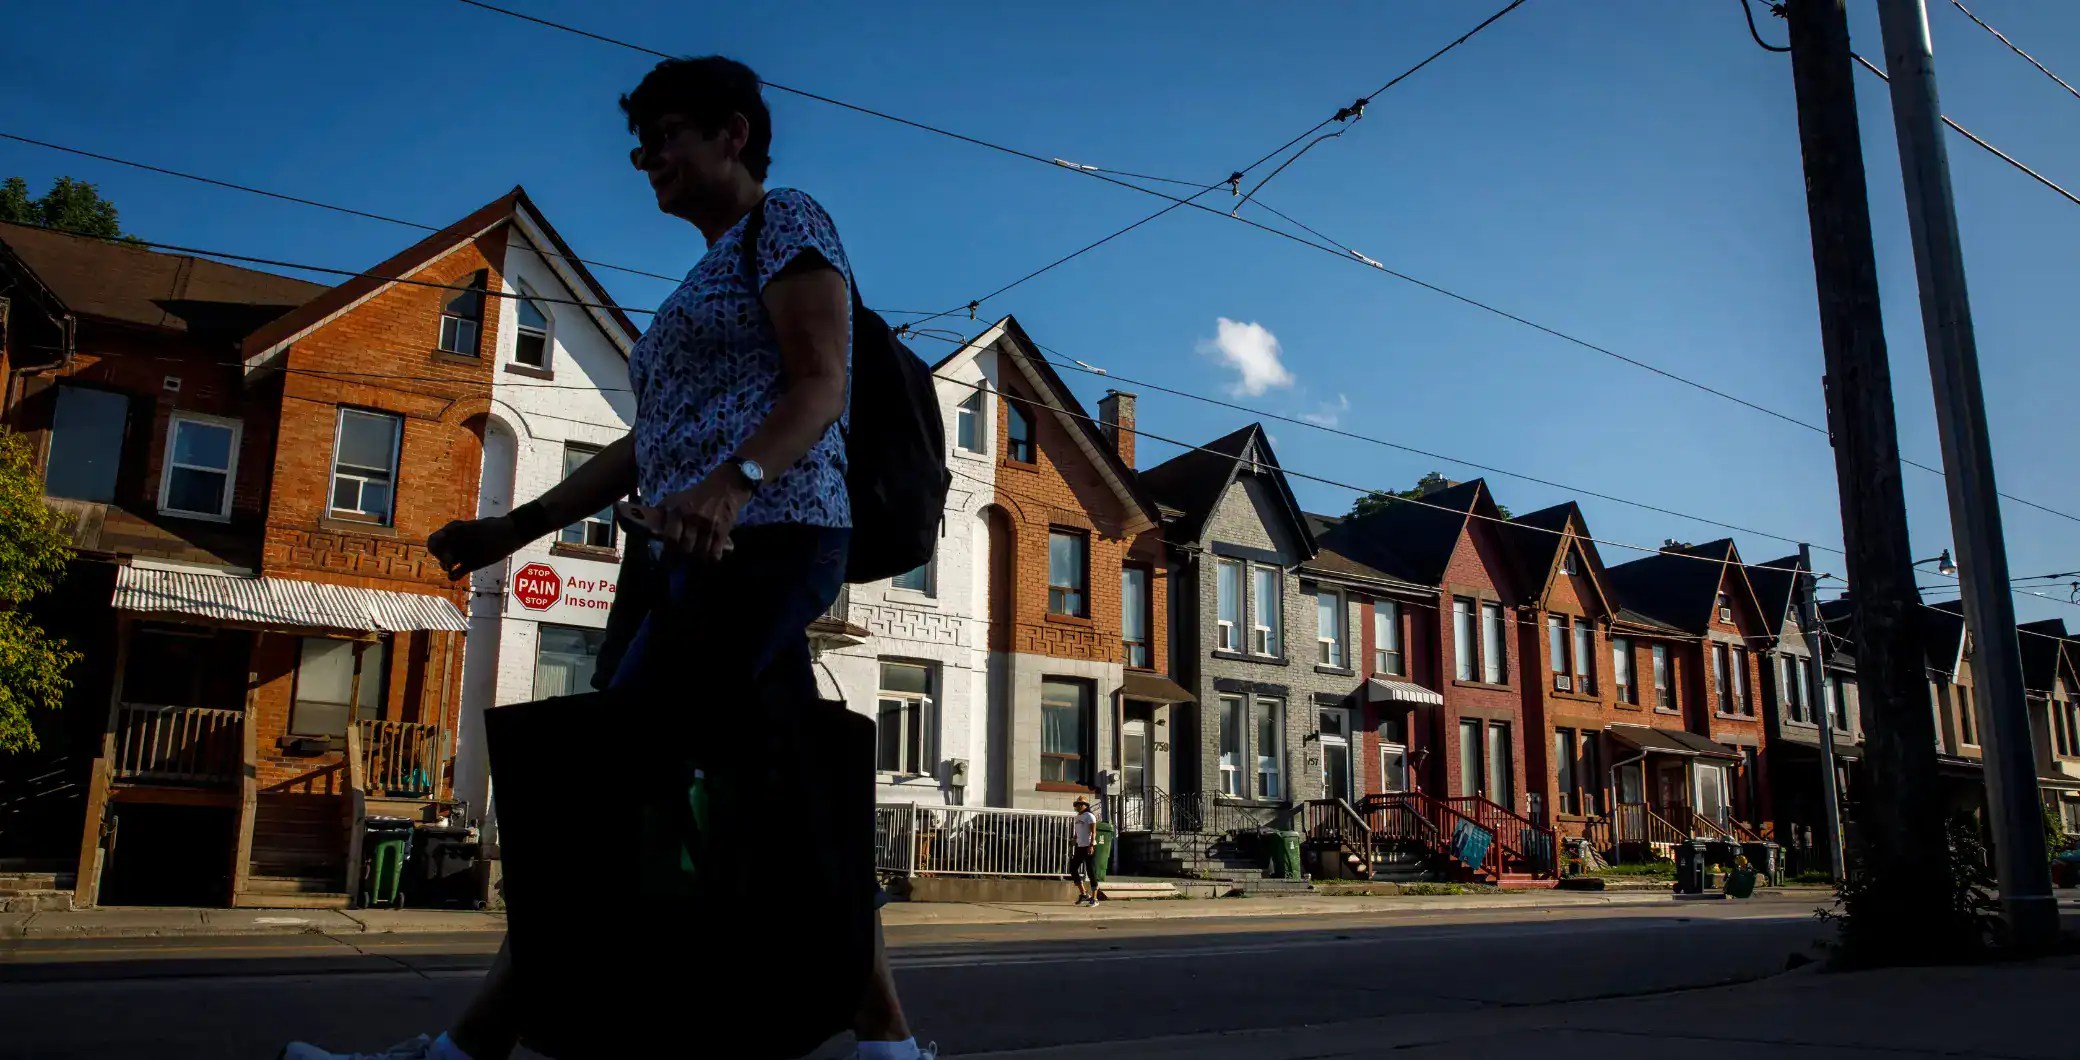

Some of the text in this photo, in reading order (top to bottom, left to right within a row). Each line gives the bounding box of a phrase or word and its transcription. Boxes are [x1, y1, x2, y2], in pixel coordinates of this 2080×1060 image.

[527, 568, 551, 577] STOP
[518, 578, 556, 596] PAIN
[567, 576, 618, 593] Any Pa
[525, 596, 548, 606] STOP
